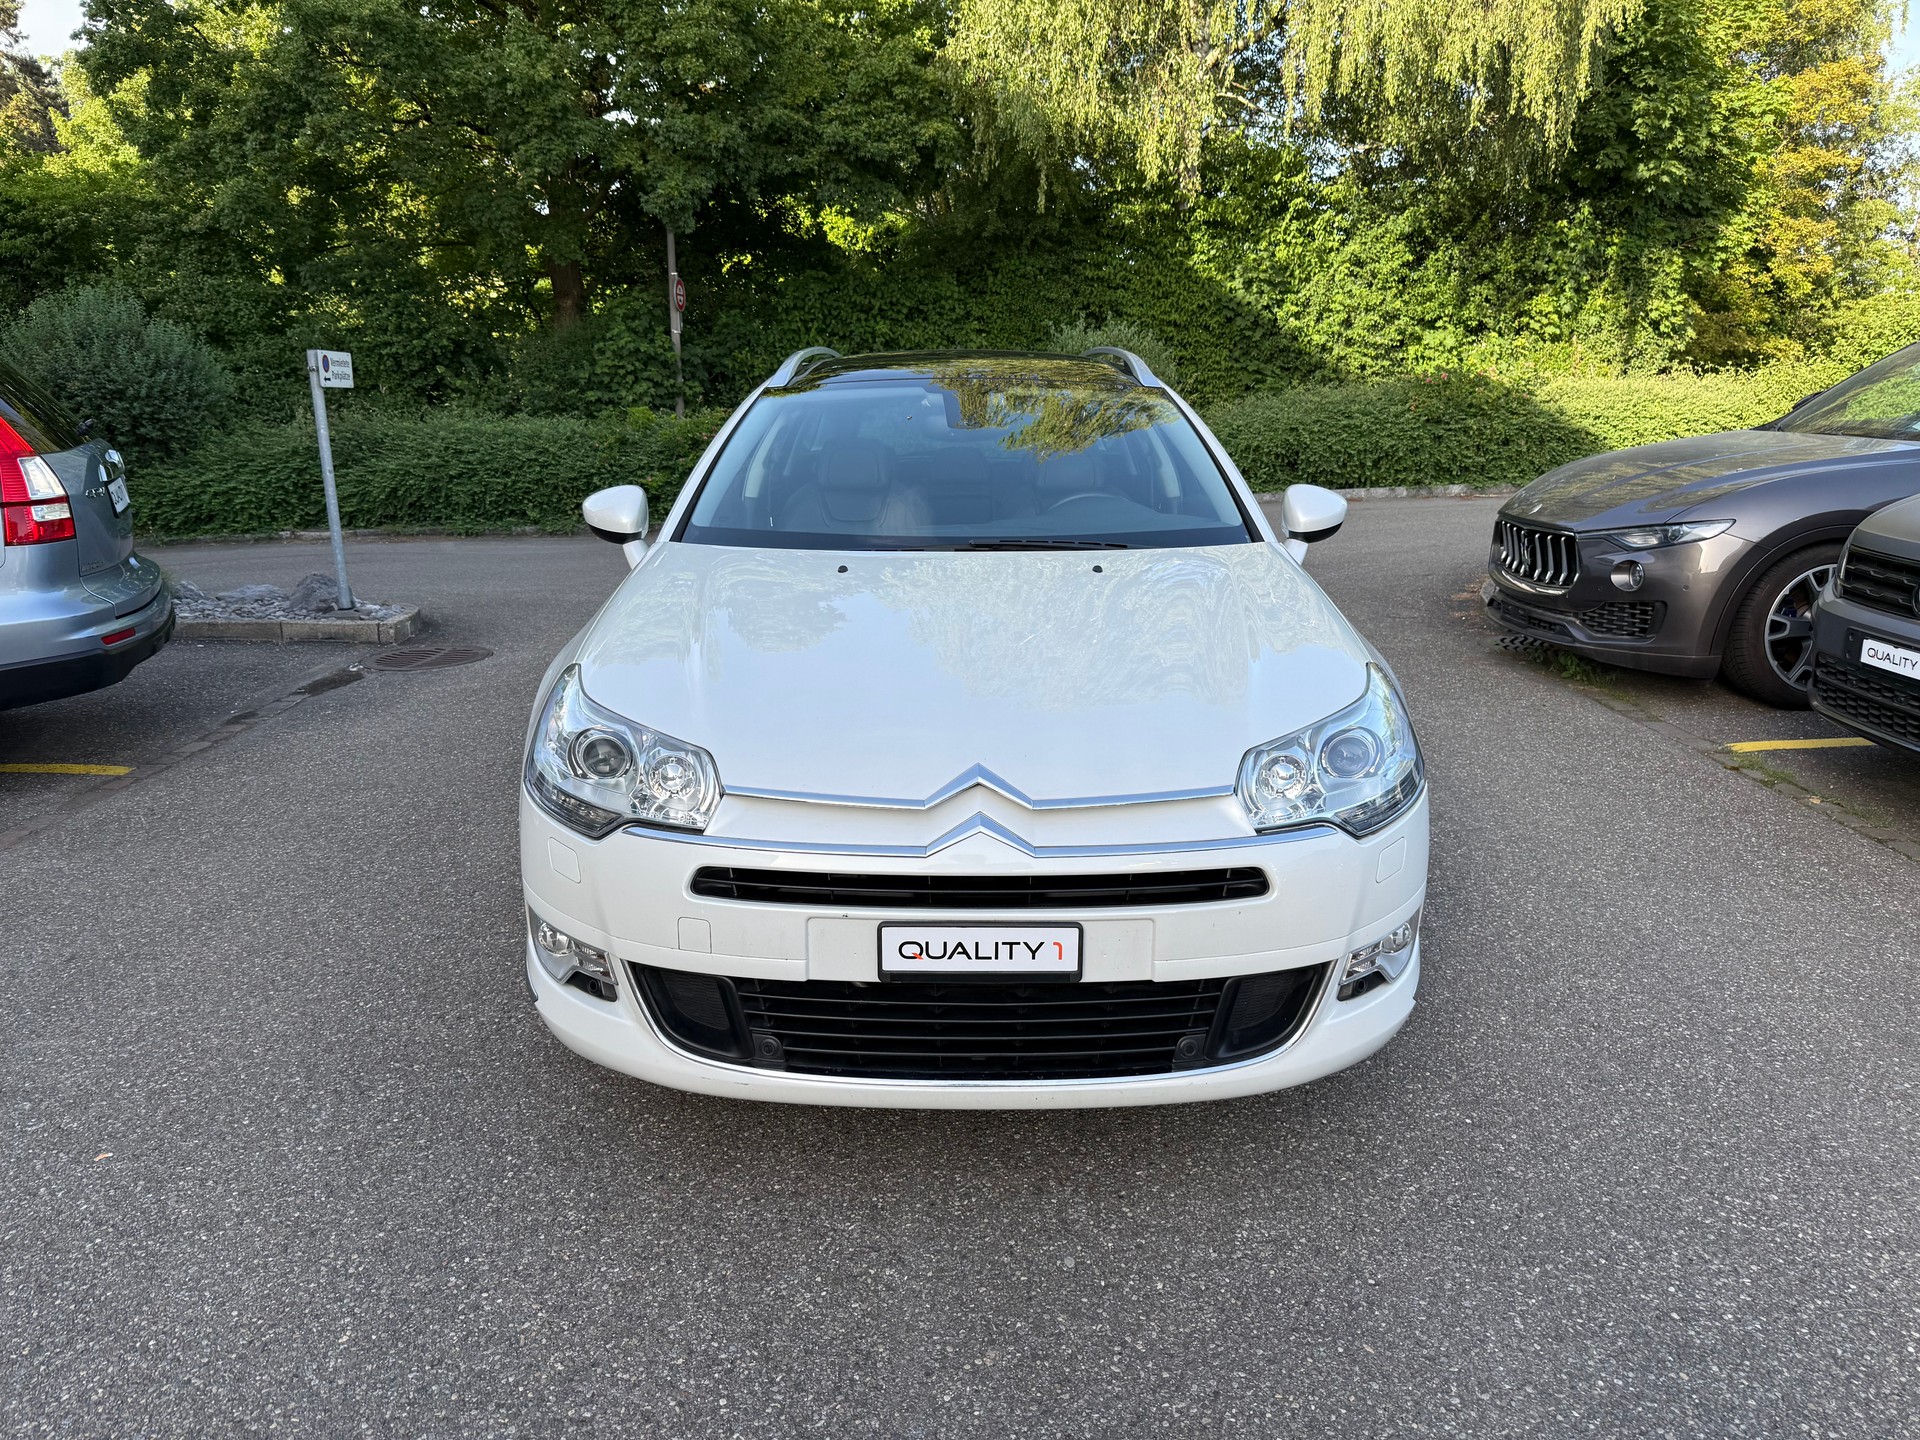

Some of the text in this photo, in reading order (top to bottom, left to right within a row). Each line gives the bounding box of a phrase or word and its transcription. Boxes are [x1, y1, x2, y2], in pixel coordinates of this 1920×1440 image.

[1867, 647, 1918, 670] QUALITY
[898, 941, 1063, 960] QUALITY 1
